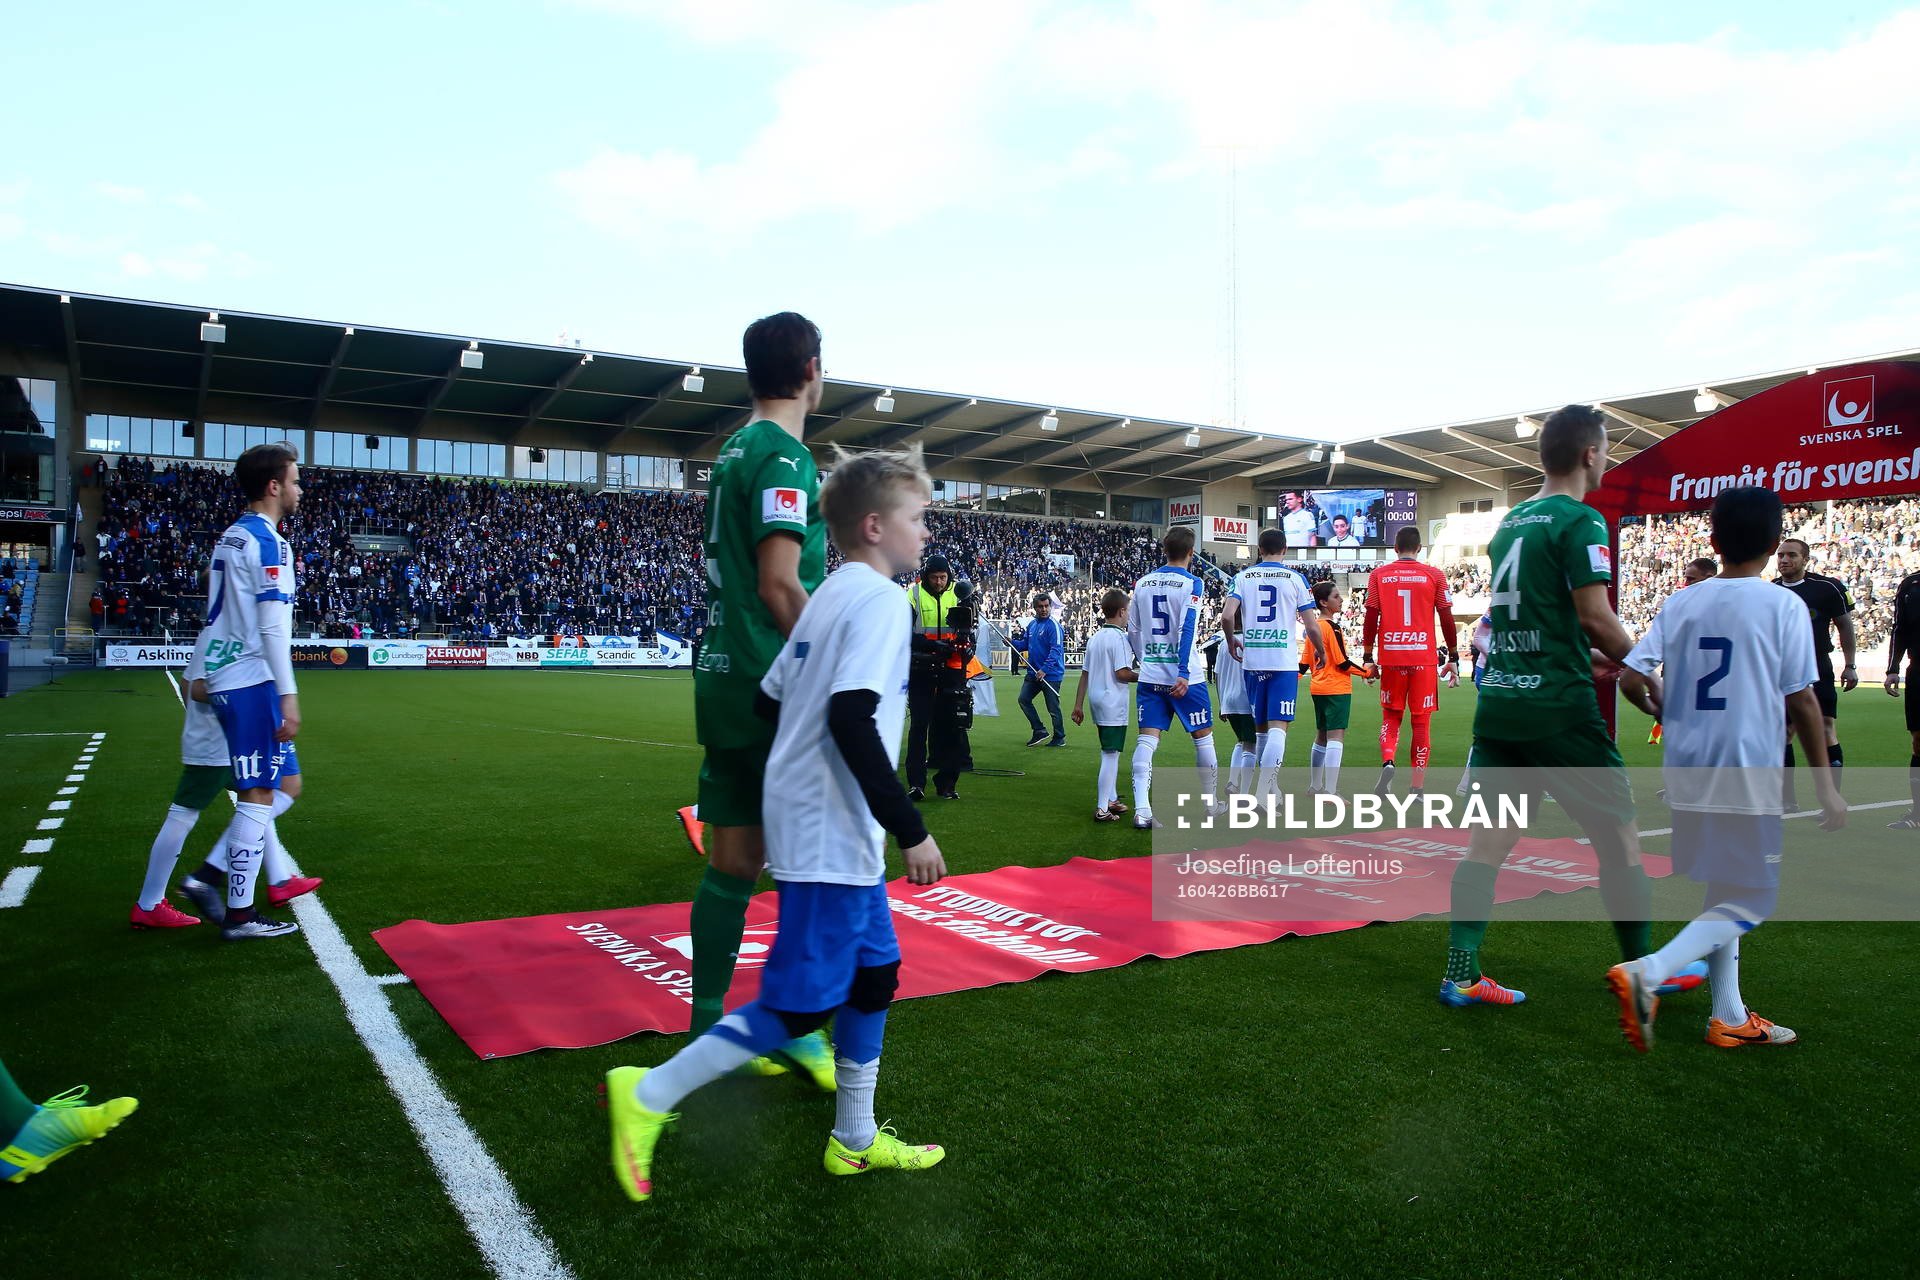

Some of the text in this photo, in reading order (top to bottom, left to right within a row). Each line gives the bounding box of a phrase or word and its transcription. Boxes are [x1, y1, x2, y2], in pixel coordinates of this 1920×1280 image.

[1799, 424, 1903, 446] SVENSKA SPEL
[1669, 464, 1768, 502] Framåt
[1772, 460, 1819, 493] för
[1387, 498, 1394, 507] 0
[1407, 498, 1414, 507] 0
[0, 510, 23, 518] epsi
[1170, 502, 1200, 518] MAXI
[1387, 511, 1414, 521] 00:00
[1213, 517, 1248, 535] MAXI
[1244, 571, 1262, 579] axs
[1382, 576, 1398, 584] axs
[1490, 536, 1525, 621] 4
[1141, 579, 1157, 588] axs
[1256, 584, 1278, 623] 3
[1397, 589, 1412, 627] 1
[1151, 594, 1170, 636] 5
[1244, 629, 1289, 640] SEFAB
[1383, 631, 1428, 643] SEFAB
[428, 648, 482, 658] XERVON
[546, 649, 589, 659] SEFAB
[597, 650, 637, 660] Scandic
[1145, 643, 1179, 655] SEFA
[291, 651, 328, 662] dbank
[391, 652, 425, 661] Lundbergs
[1696, 636, 1734, 711] 2
[1279, 699, 1296, 716] nt
[1189, 708, 1208, 726] nt
[231, 749, 263, 780] nt
[566, 922, 668, 973] SVENSKA
